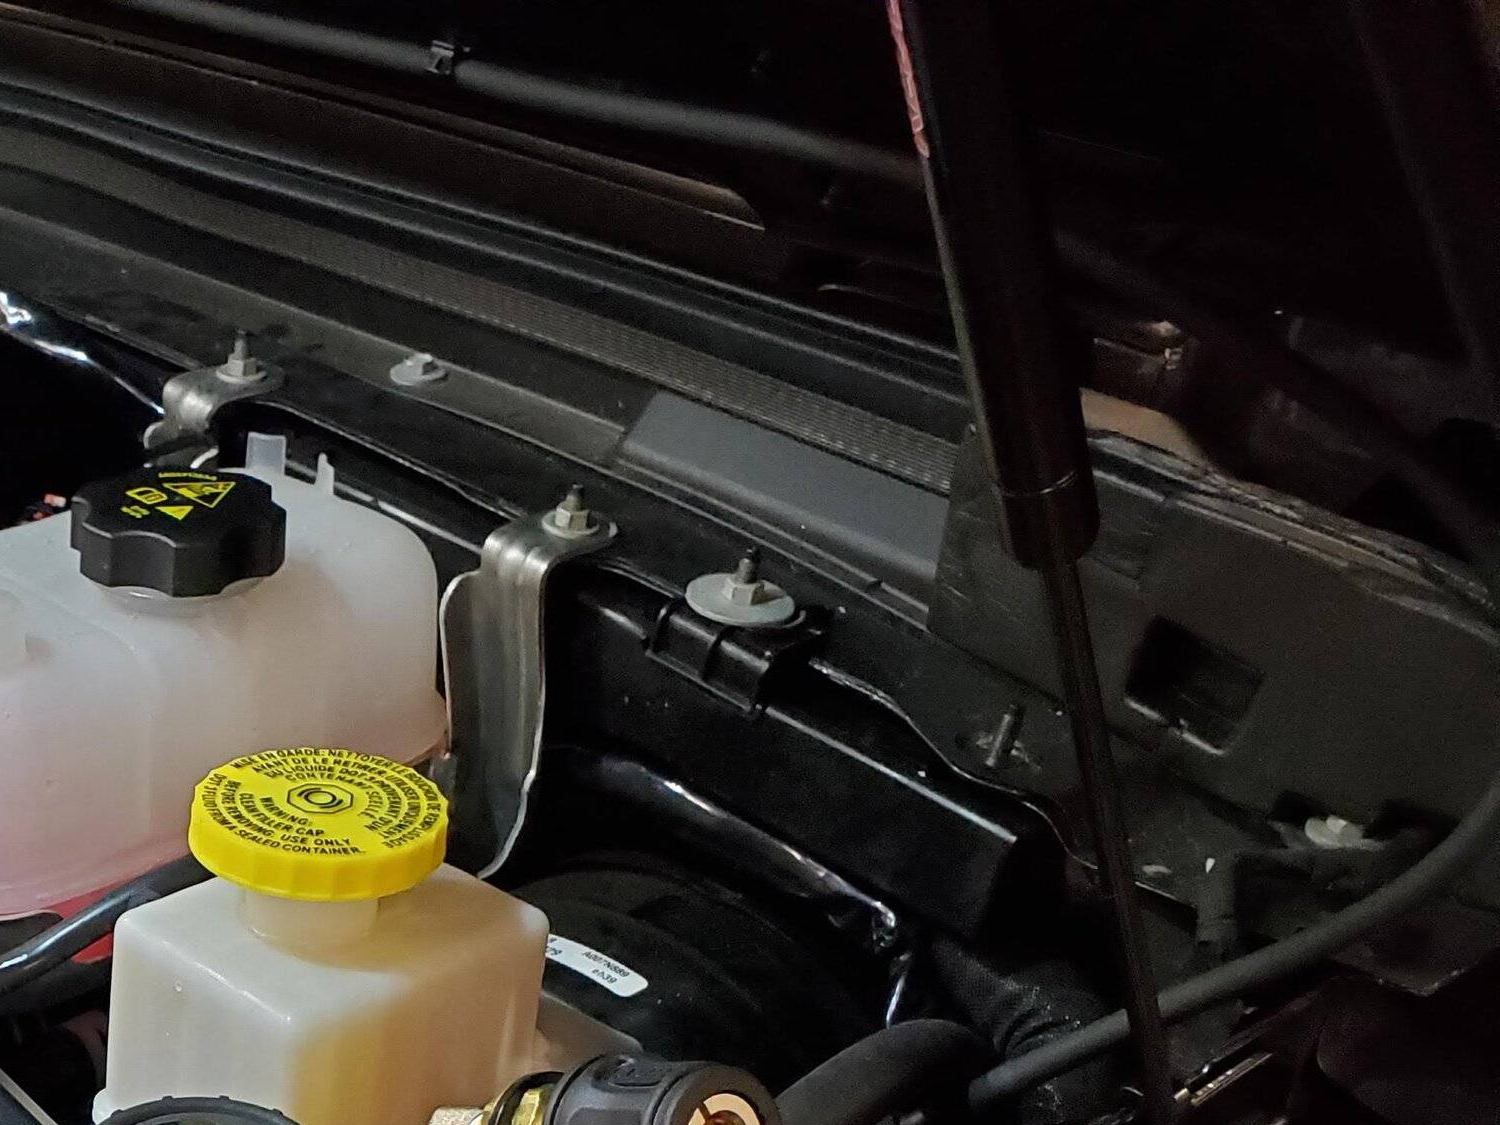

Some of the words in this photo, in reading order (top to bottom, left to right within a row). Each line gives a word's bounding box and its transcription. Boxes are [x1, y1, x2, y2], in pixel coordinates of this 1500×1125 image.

[313, 757, 328, 765] LE
[328, 749, 393, 768] NETTOYER
[283, 765, 334, 773] LIQUIDE
[339, 768, 367, 778] DOT
[220, 780, 242, 804] BEFORE
[280, 834, 308, 844] USE
[314, 838, 351, 846] ONLY
[239, 793, 259, 813] CLEAN
[252, 812, 293, 833] FILLER
[295, 827, 325, 837] CAP
[234, 829, 281, 848] SEALED
